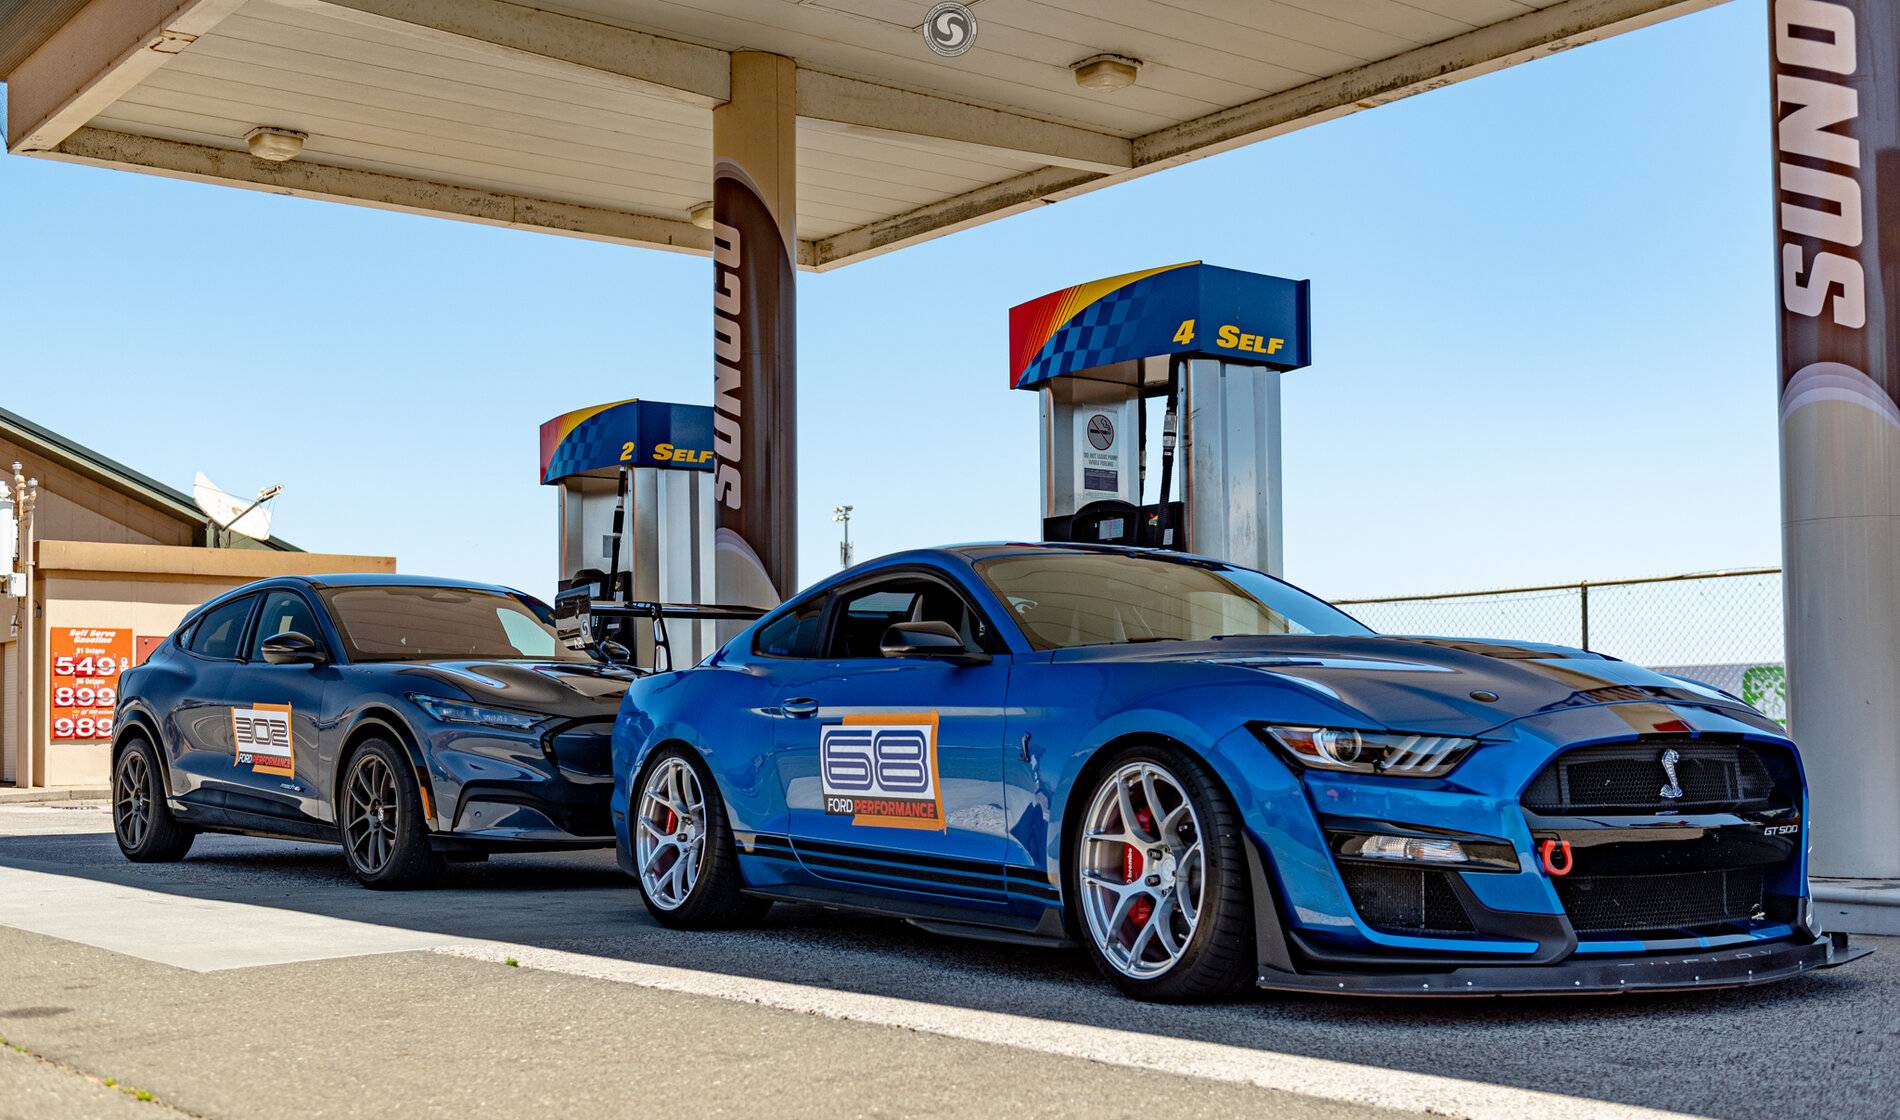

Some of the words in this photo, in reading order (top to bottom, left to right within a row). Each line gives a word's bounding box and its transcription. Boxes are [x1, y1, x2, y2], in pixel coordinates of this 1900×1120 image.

[1775, 0, 1866, 329] SUNO
[1172, 318, 1196, 346] 4
[619, 441, 635, 462] 2
[235, 717, 288, 747] 302
[239, 753, 253, 764] FORD
[253, 755, 290, 768] PERFORMANCE
[823, 730, 929, 793] 68
[826, 797, 853, 813] FORD
[854, 800, 935, 817] PERFORMANCE
